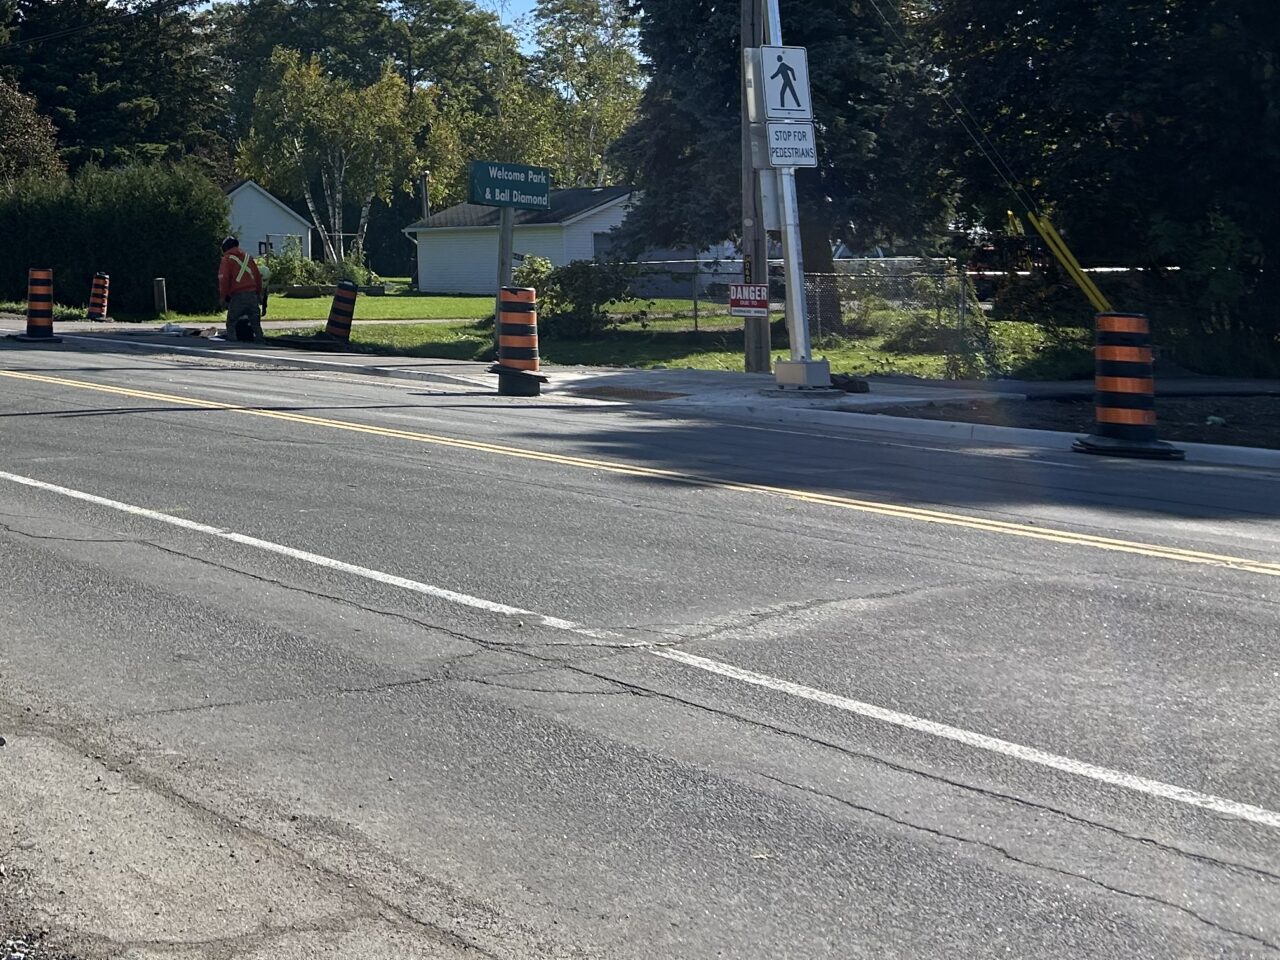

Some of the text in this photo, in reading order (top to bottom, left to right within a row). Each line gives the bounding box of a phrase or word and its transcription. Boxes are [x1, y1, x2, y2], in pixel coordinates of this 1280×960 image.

[775, 130, 807, 141] STOP FOR
[771, 147, 814, 159] PEDESTRIANS
[488, 166, 546, 184] Welcome Park
[485, 187, 548, 206] & Ball Diamond
[731, 286, 767, 301] DANGER
